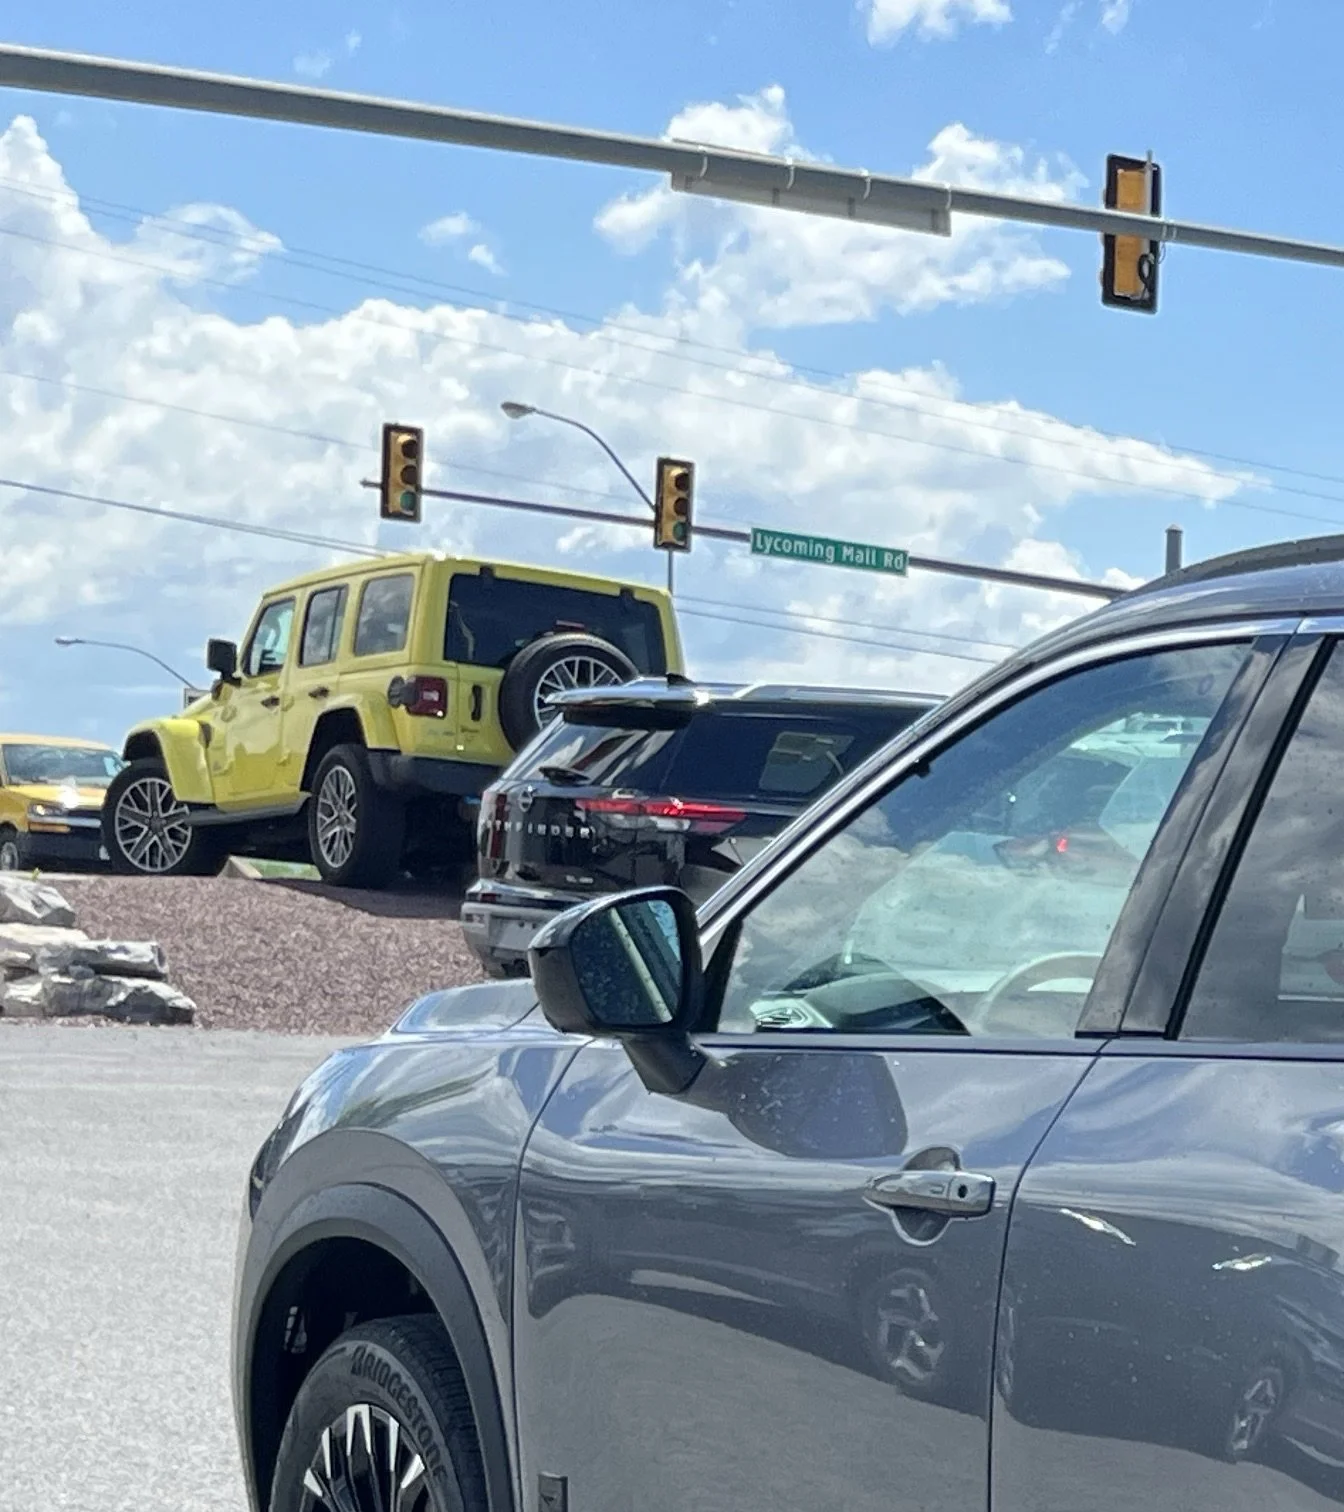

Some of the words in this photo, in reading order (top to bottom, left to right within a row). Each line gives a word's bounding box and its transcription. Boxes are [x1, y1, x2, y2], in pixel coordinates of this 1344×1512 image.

[755, 533, 835, 563] Lycoming
[842, 545, 876, 565] Mall
[884, 552, 904, 569] Rd
[482, 817, 590, 839] THFINDER
[351, 1344, 448, 1482] BRIDGESTONE
